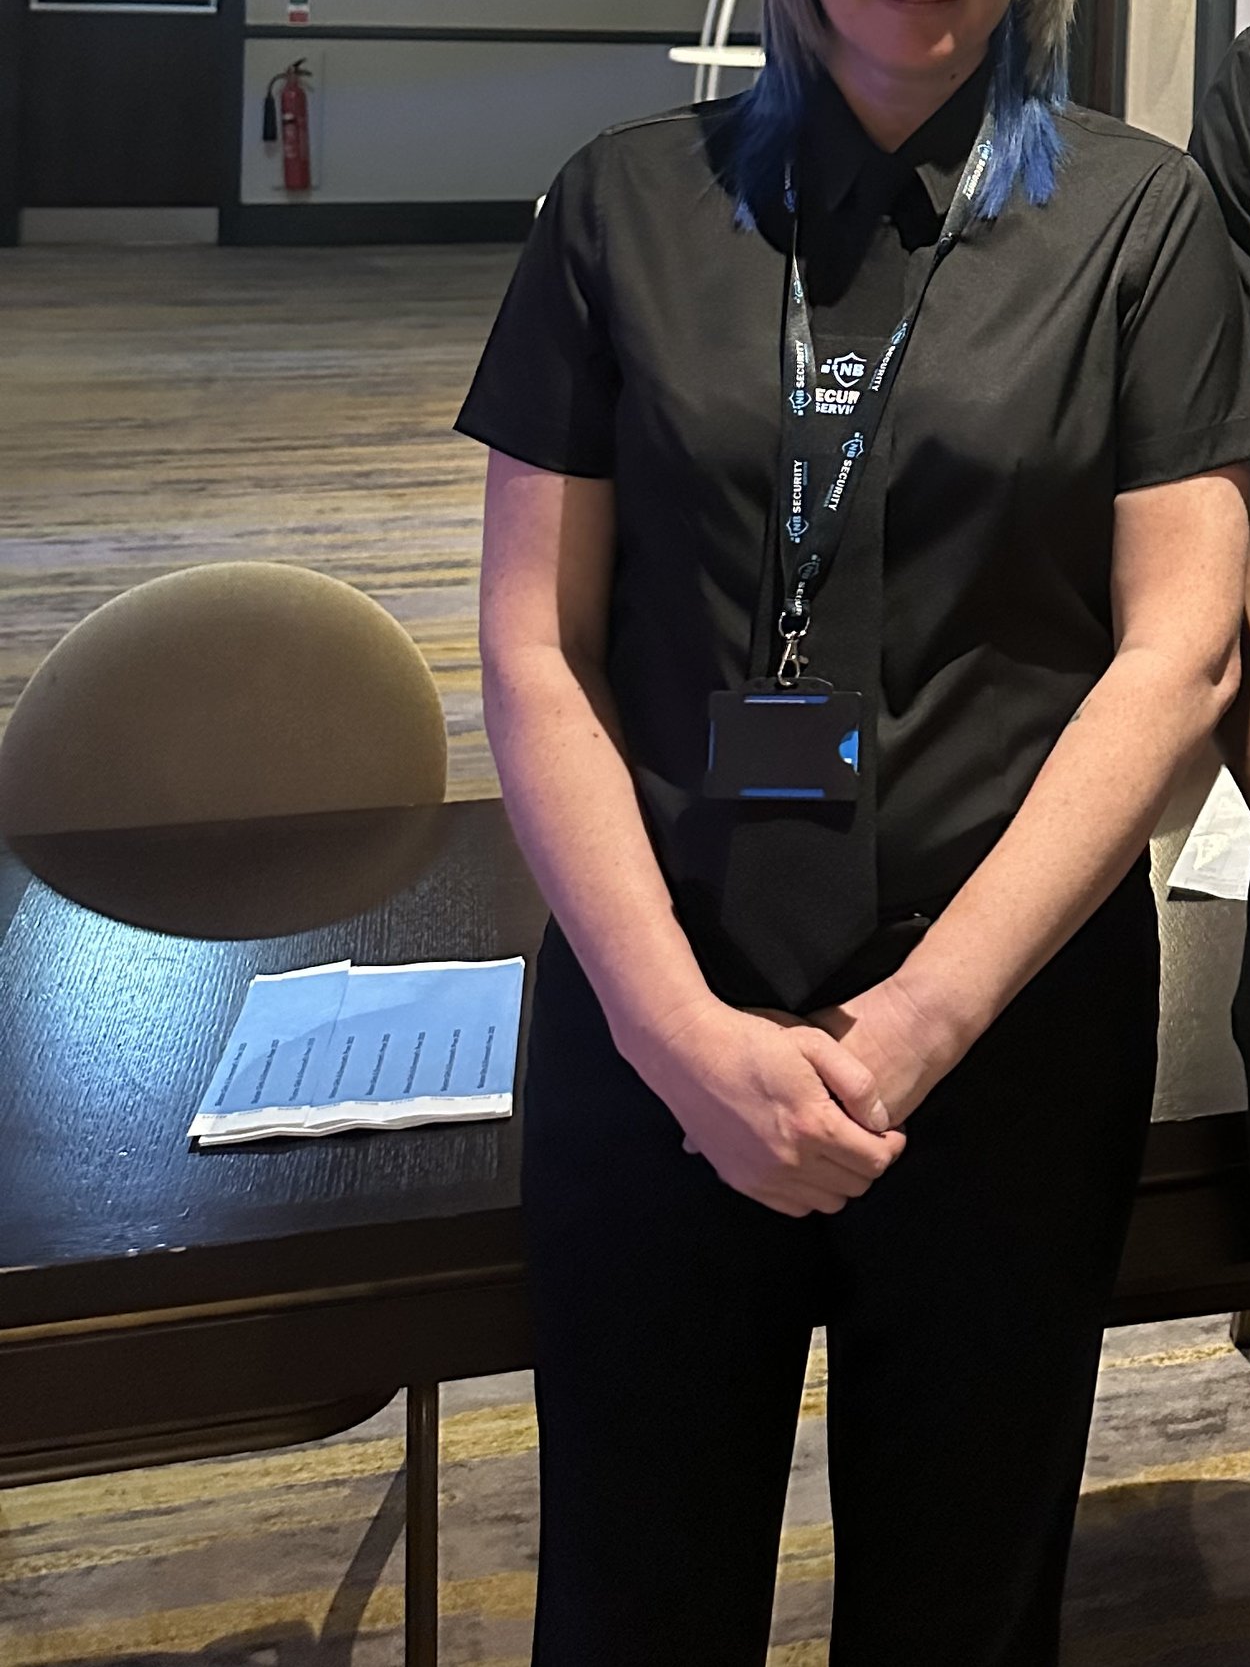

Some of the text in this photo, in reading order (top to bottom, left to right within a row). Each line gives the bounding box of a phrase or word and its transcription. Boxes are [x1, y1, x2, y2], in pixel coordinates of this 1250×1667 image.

[965, 159, 986, 200] SECURITY
[795, 340, 805, 388] SECURITY
[839, 362, 865, 377] NB
[871, 345, 896, 391] SECURITY
[815, 388, 860, 404] ECUR
[846, 443, 858, 459] NB
[792, 460, 803, 531] NB SECURITY
[828, 459, 853, 511] SECURITY
